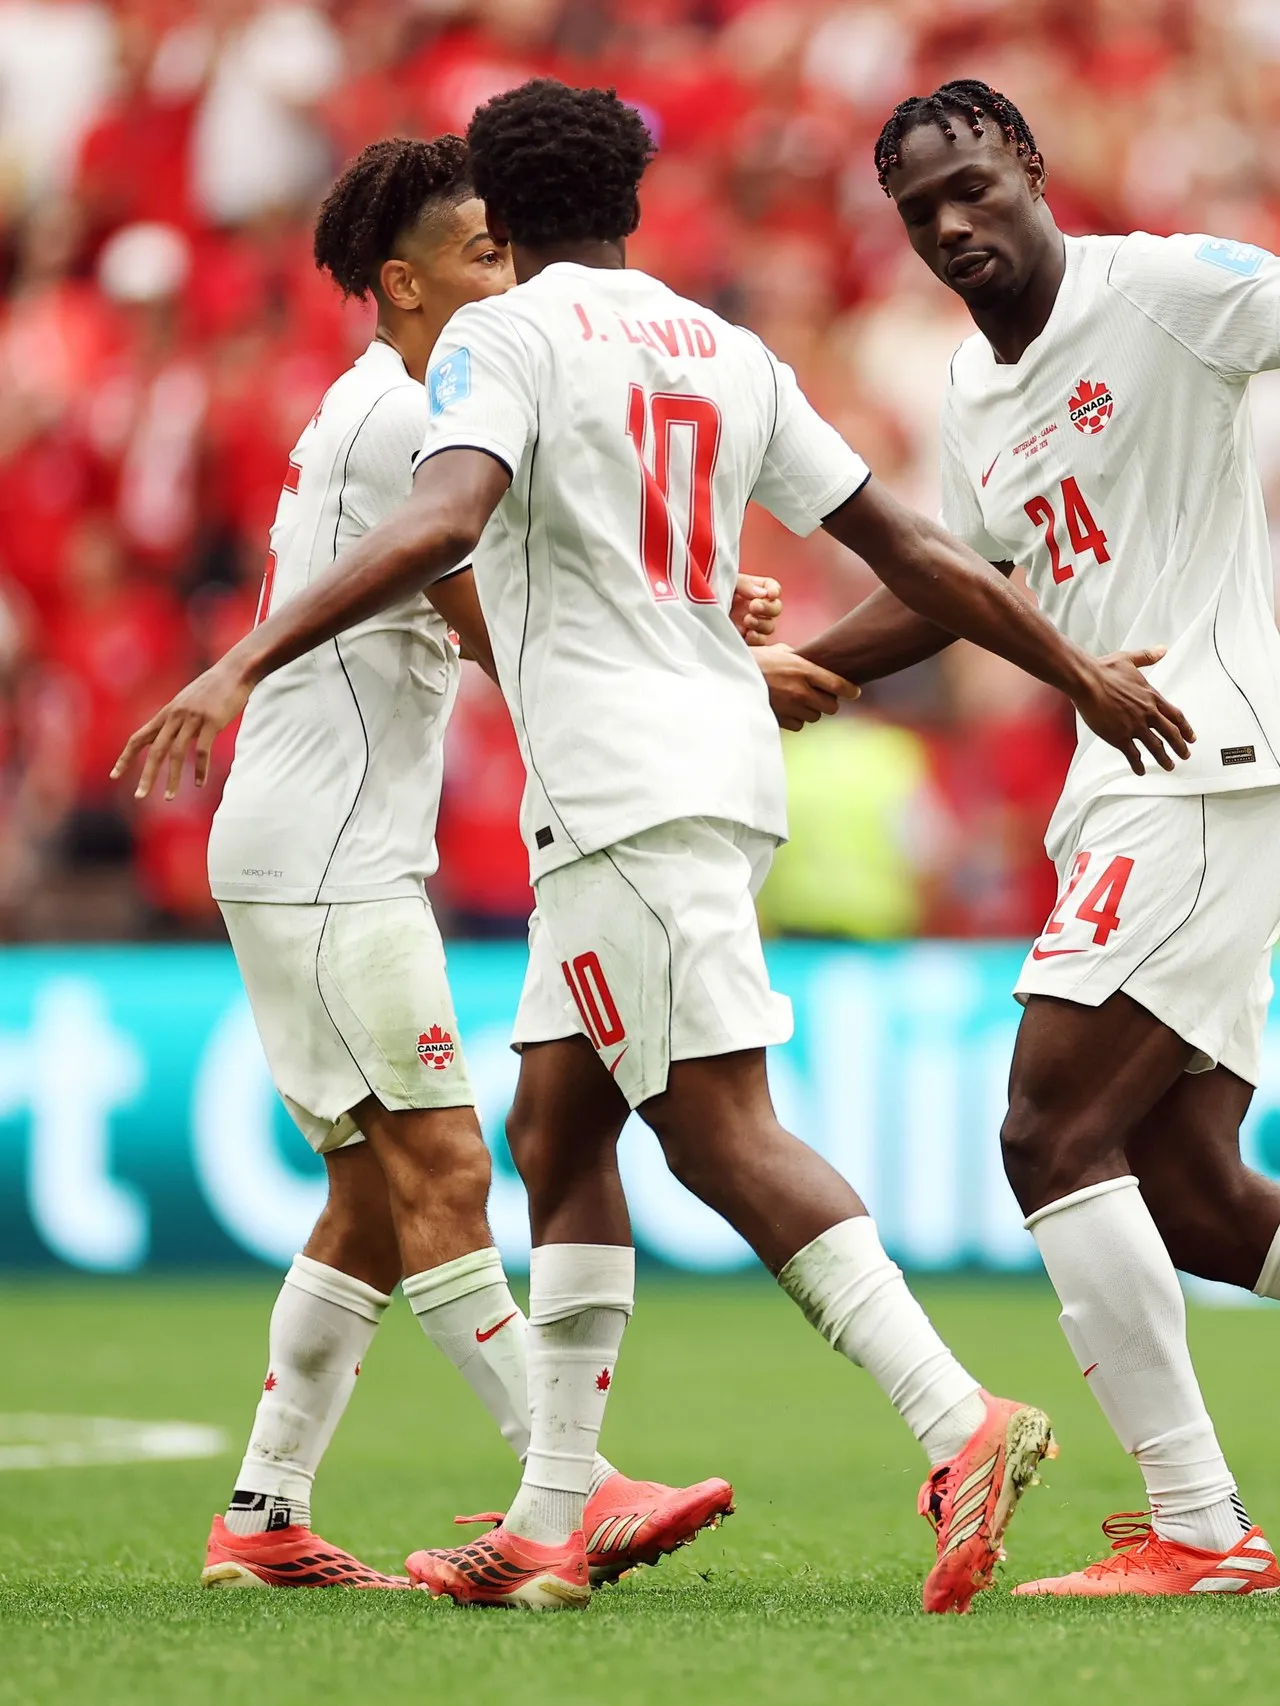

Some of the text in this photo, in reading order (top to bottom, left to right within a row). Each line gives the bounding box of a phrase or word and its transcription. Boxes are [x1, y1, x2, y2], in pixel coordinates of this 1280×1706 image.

[572, 303, 609, 342] J.
[1070, 393, 1113, 421] CANADA
[625, 382, 724, 605] 10
[1023, 476, 1111, 585] 24
[241, 868, 283, 878] AERO-FIT
[1045, 851, 1135, 947] 24
[561, 951, 626, 1051] 10
[417, 1043, 454, 1053] CANADA
